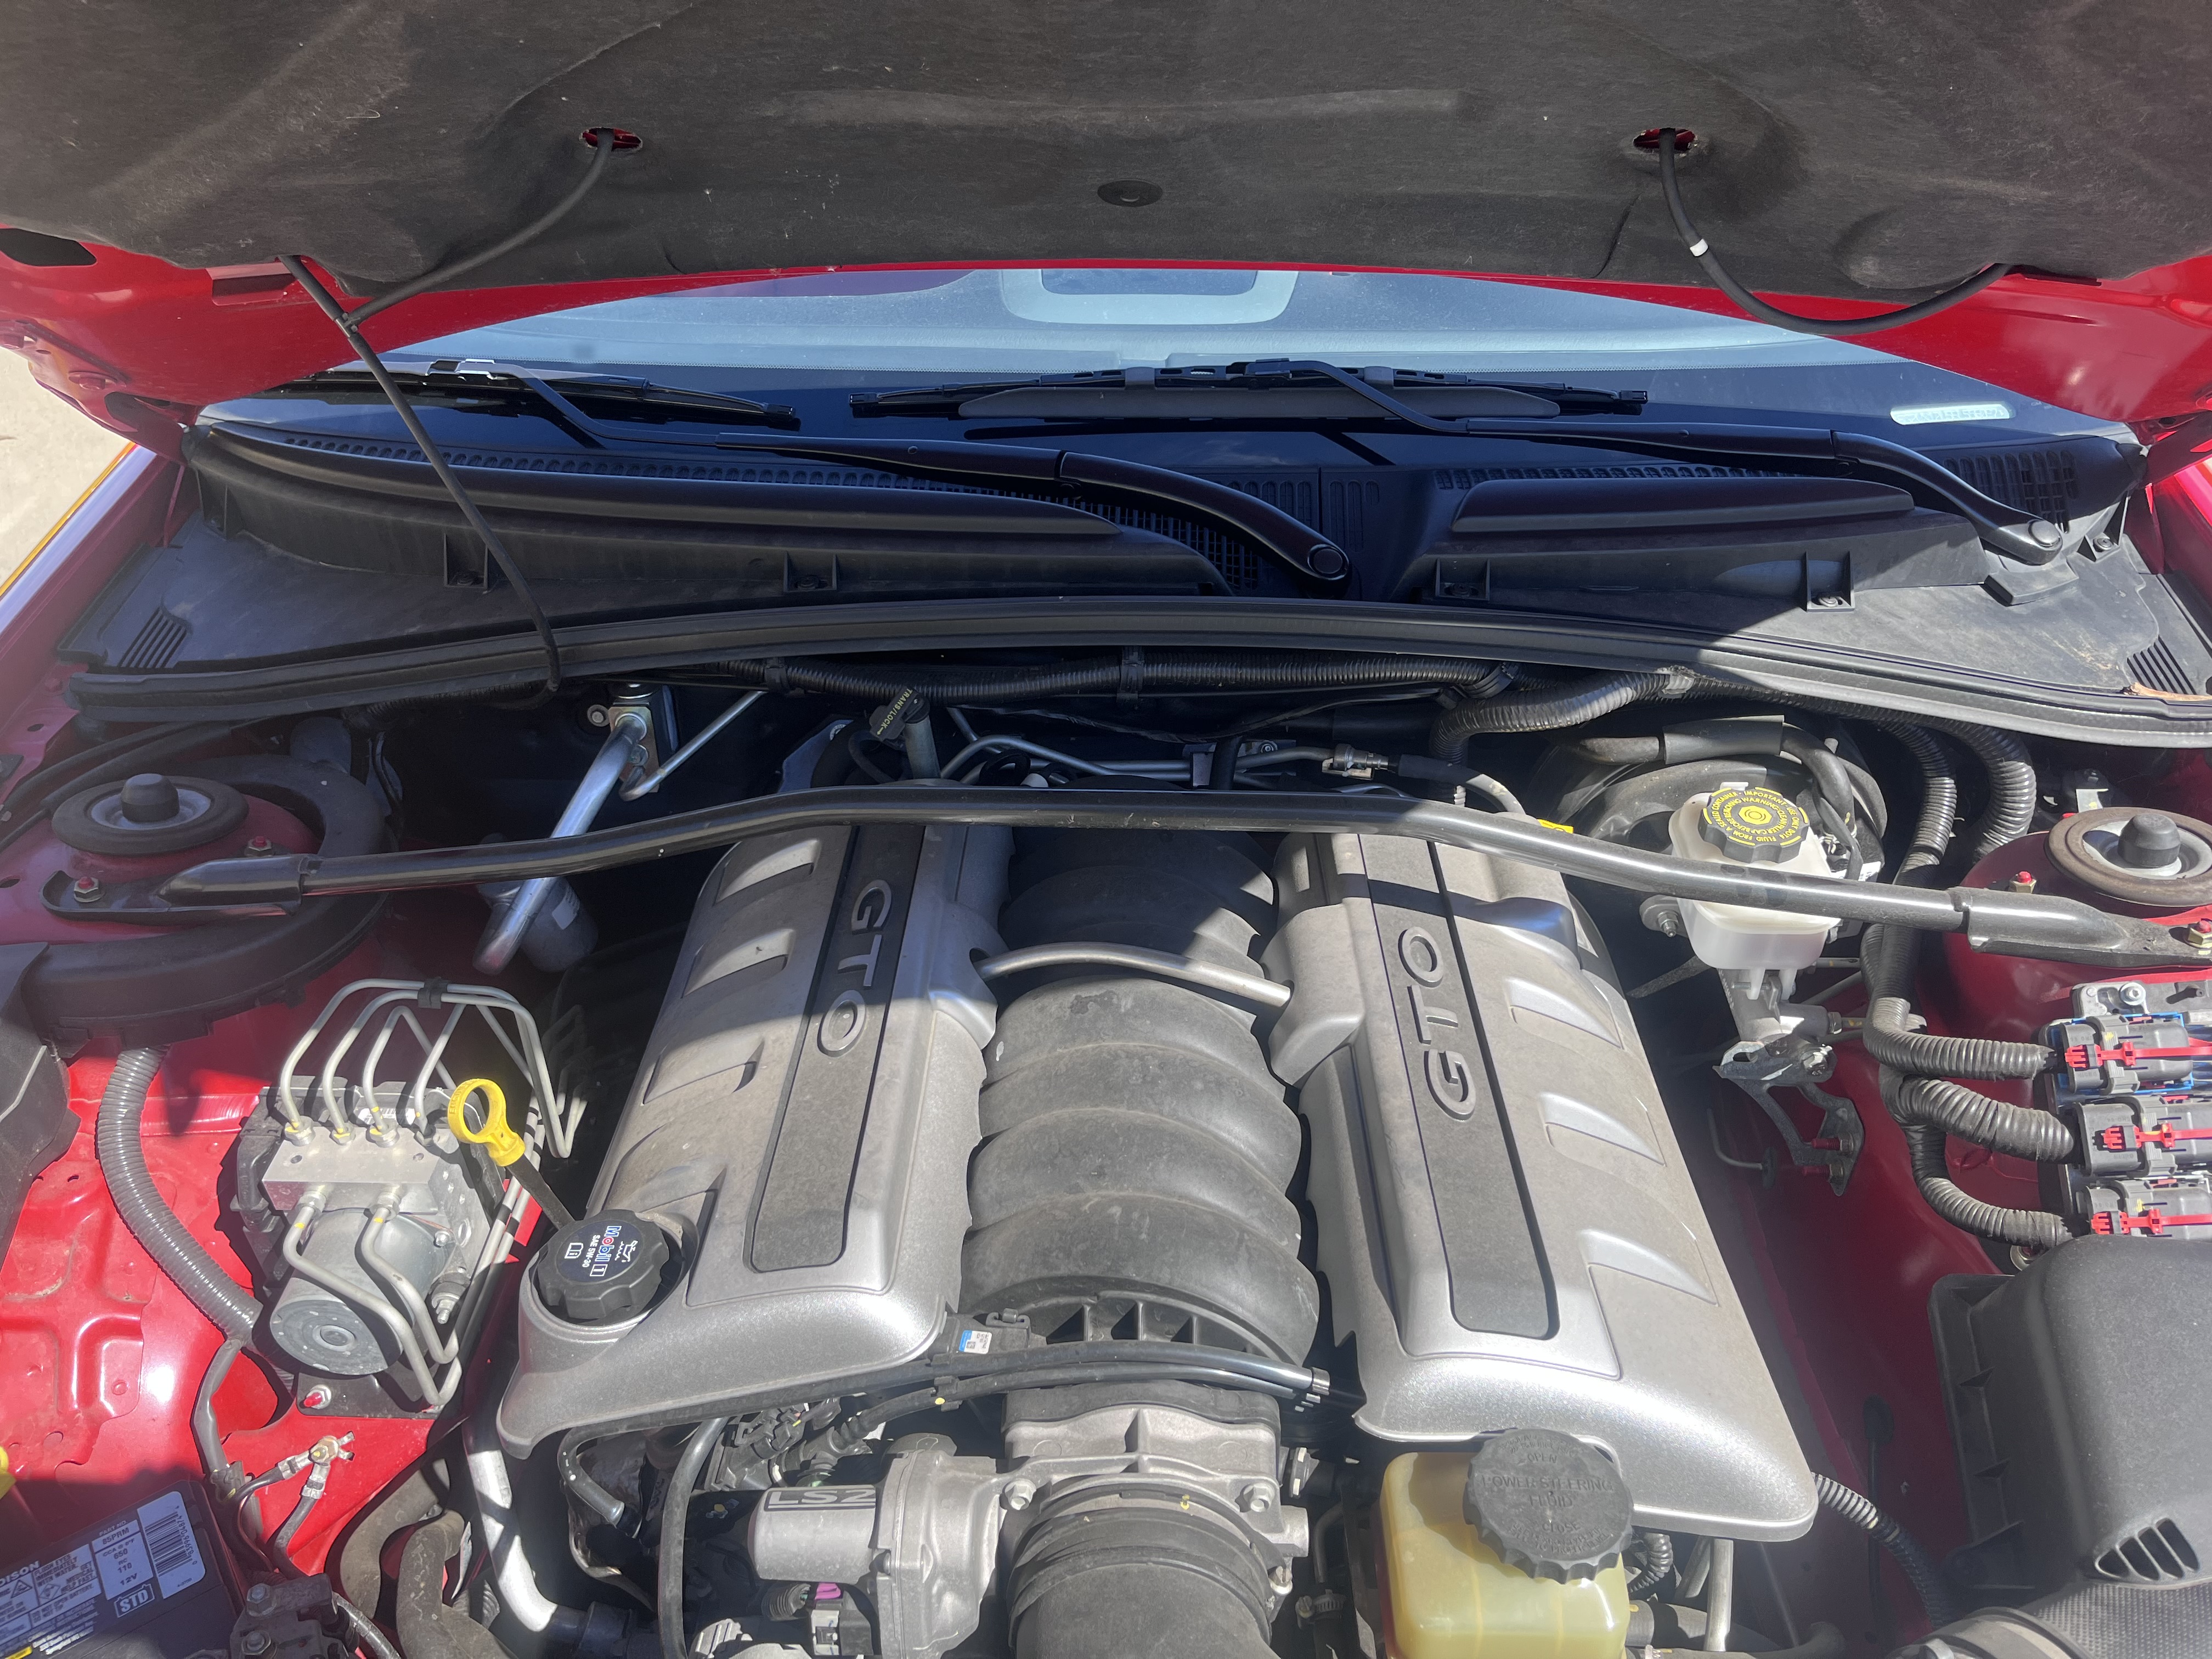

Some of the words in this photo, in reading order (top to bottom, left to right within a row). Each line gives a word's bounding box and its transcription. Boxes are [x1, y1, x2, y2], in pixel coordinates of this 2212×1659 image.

[881, 689, 913, 729] TRANS/LOCK
[1711, 792, 1738, 810] CONTAINER
[1743, 791, 1787, 805] IMPORTANT
[1723, 798, 1742, 817] REMOVING
[1786, 807, 1797, 815] USE
[1711, 811, 1727, 827] SEALED
[1778, 809, 1787, 824] CLEAN
[1726, 818, 1751, 833] BEFORE
[1733, 830, 1752, 840] FROM
[817, 879, 892, 1057] GTO
[1398, 926, 1477, 1121] GTO
[590, 1234, 601, 1247] SAE
[595, 1226, 622, 1262] Mobil
[582, 1248, 596, 1267] 5W-30
[1527, 1453, 1557, 1464] OPEN
[1482, 1475, 1537, 1488] POWER
[1539, 1477, 1613, 1492] STEERING
[769, 1488, 876, 1504] LS2
[1530, 1494, 1573, 1508] FLUID
[99, 1525, 115, 1536] PART
[177, 1515, 188, 1535] 04874
[1542, 1522, 1581, 1533] CLOSE
[102, 1527, 129, 1545] 85PRM
[103, 1547, 116, 1556] CCA
[184, 1535, 194, 1556] 83996
[114, 1548, 128, 1559] 650
[117, 1562, 132, 1573] 110
[120, 1573, 137, 1586] 12V
[120, 1589, 149, 1612] STD
